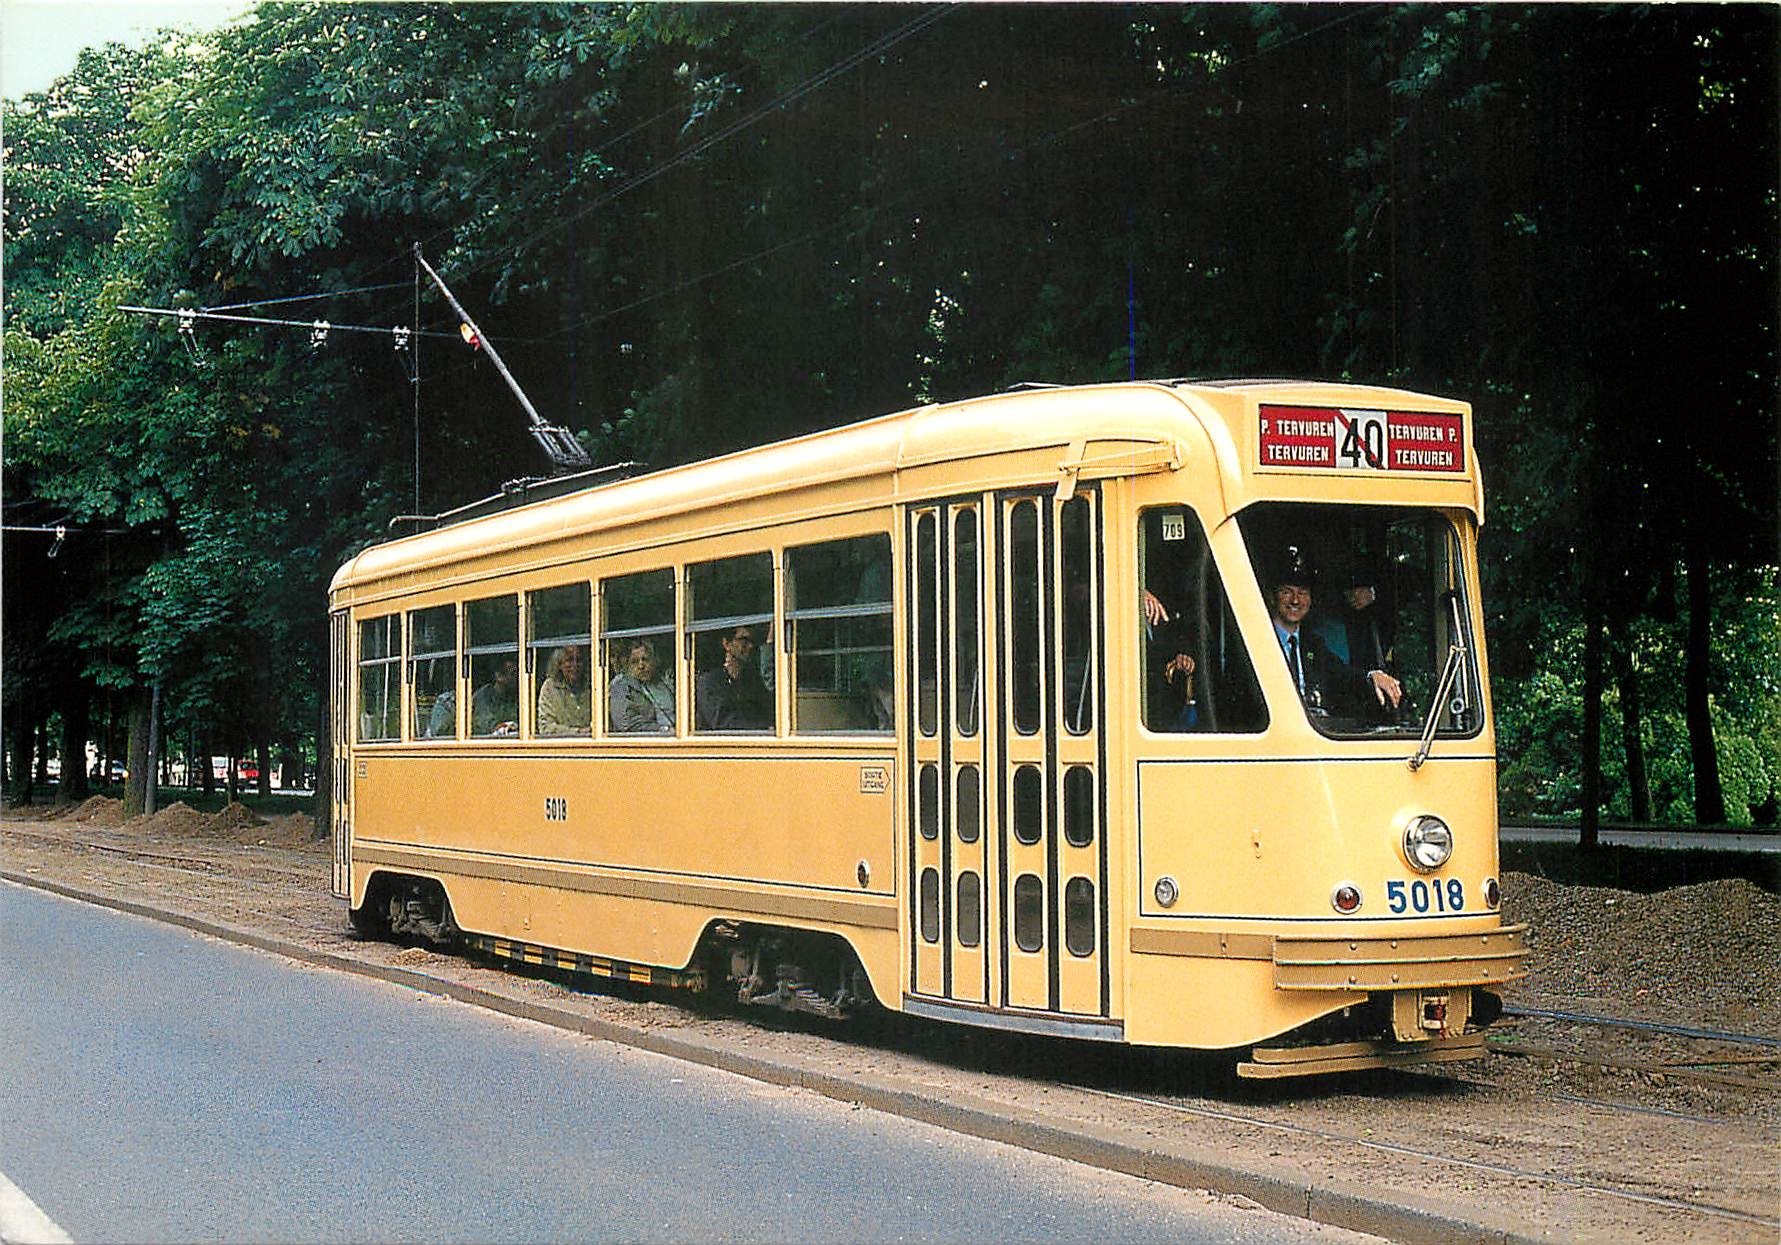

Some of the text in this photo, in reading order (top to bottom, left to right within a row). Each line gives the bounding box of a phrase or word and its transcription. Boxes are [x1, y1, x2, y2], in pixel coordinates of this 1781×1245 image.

[1261, 419, 1334, 437] P. TERVUREN
[1388, 424, 1458, 443] TERVUREN P.
[1341, 417, 1383, 468] 40
[1267, 444, 1329, 461] TERVUREN
[1395, 449, 1453, 466] TERVUREN
[1163, 523, 1183, 538] 709
[545, 798, 567, 821] 5018
[1387, 878, 1464, 914] 5018
